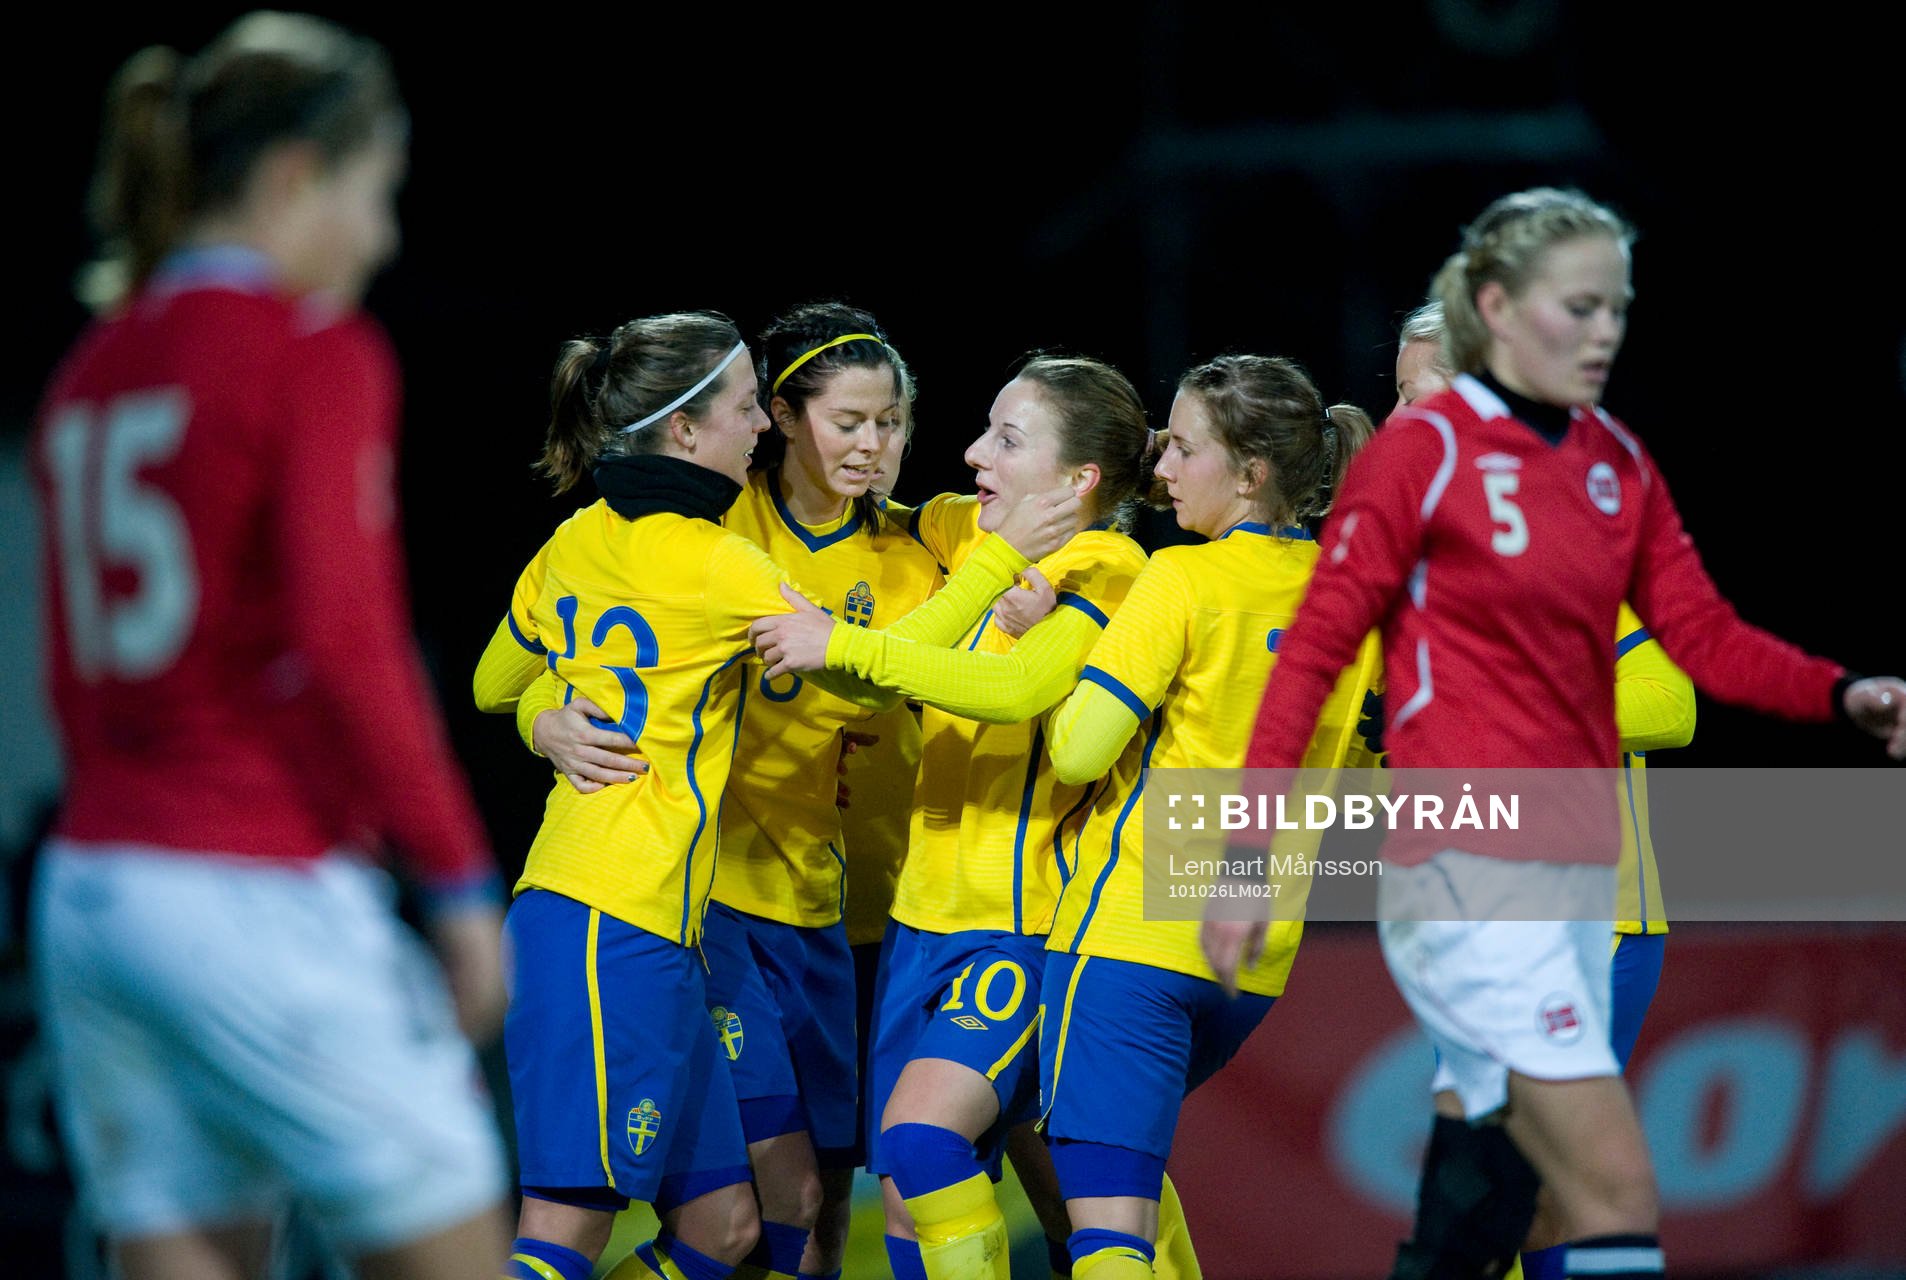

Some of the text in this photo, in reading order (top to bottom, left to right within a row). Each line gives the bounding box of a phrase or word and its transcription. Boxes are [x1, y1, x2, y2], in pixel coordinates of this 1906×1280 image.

[48, 387, 196, 682] 15
[1482, 473, 1529, 556] 5
[941, 960, 1027, 1021] 10
